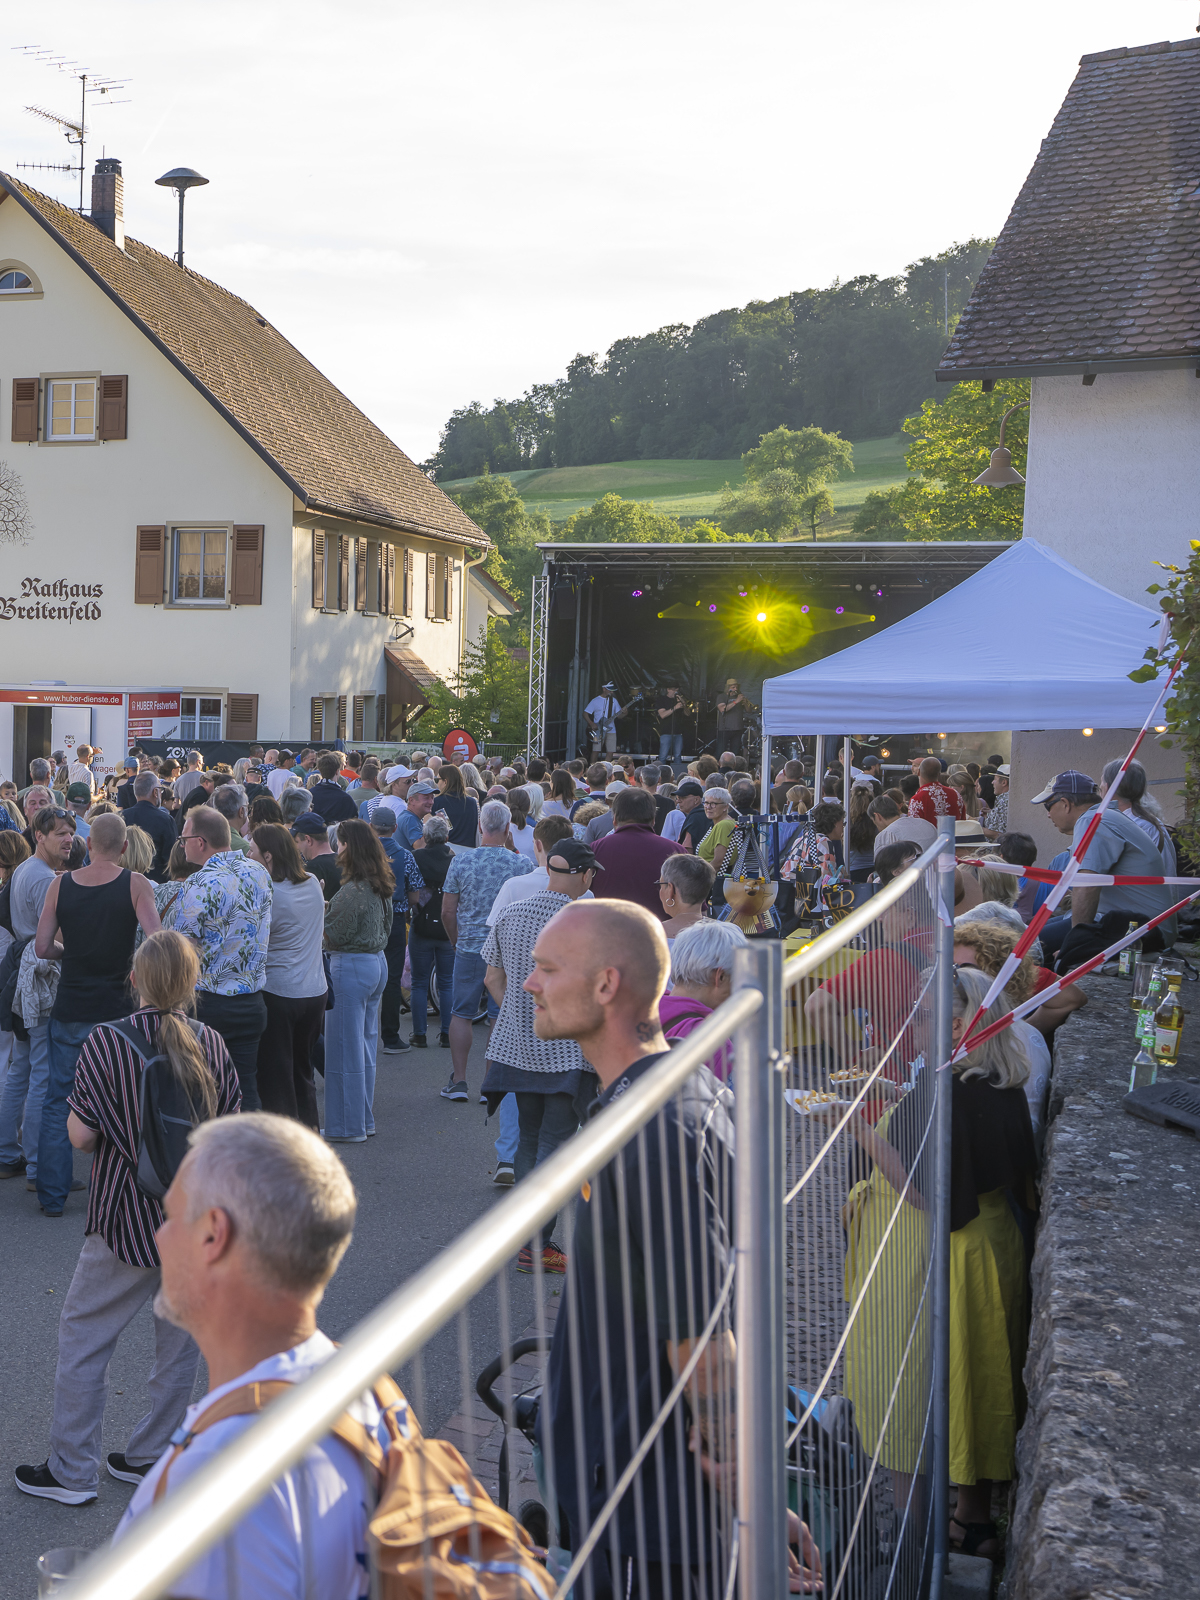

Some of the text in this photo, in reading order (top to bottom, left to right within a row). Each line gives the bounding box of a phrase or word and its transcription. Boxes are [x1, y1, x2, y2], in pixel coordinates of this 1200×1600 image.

[20, 577, 104, 601] Rathaus
[43, 694, 120, 704] www.huber-dienste.de
[136, 700, 178, 711] HUBER Festverleih
[1148, 982, 1162, 991] EIS
